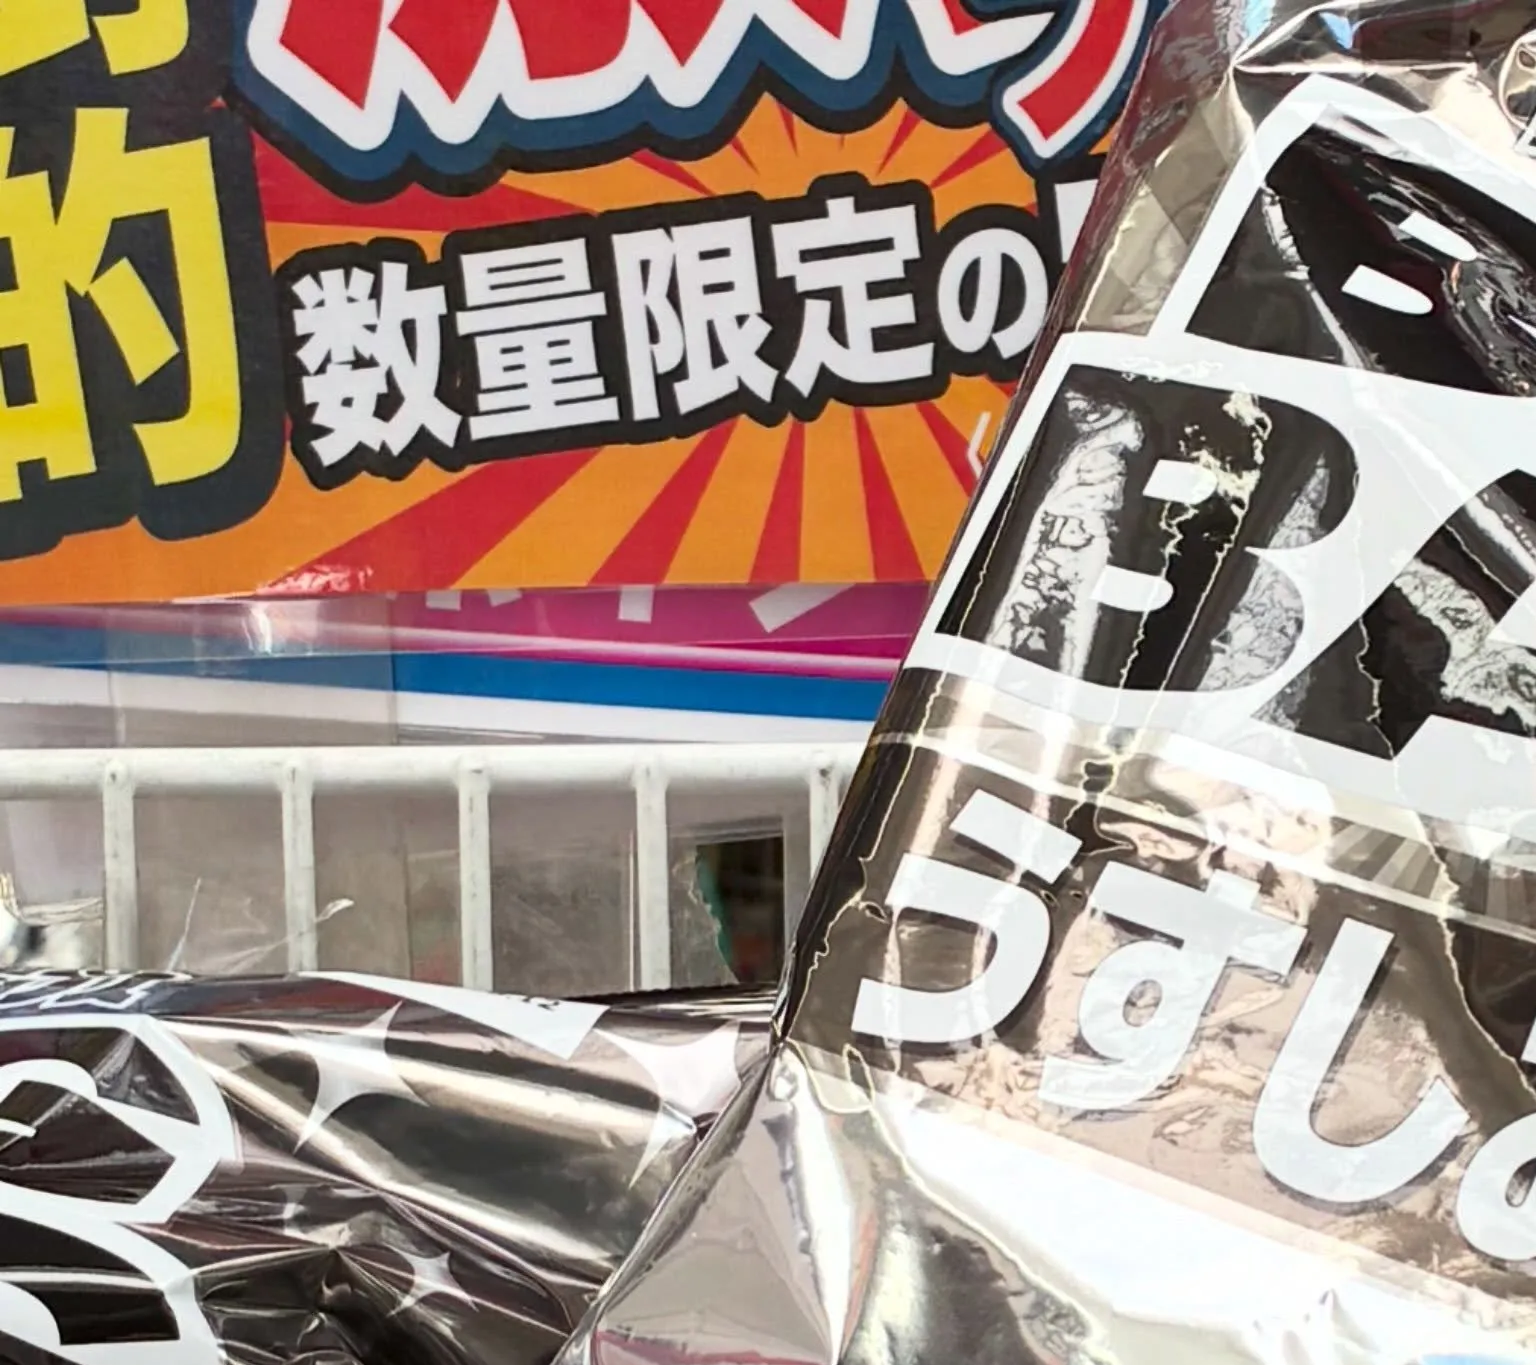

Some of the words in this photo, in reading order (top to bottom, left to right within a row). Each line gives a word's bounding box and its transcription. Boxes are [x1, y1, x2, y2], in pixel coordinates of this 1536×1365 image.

[292, 178, 1100, 468] 数量限定の
